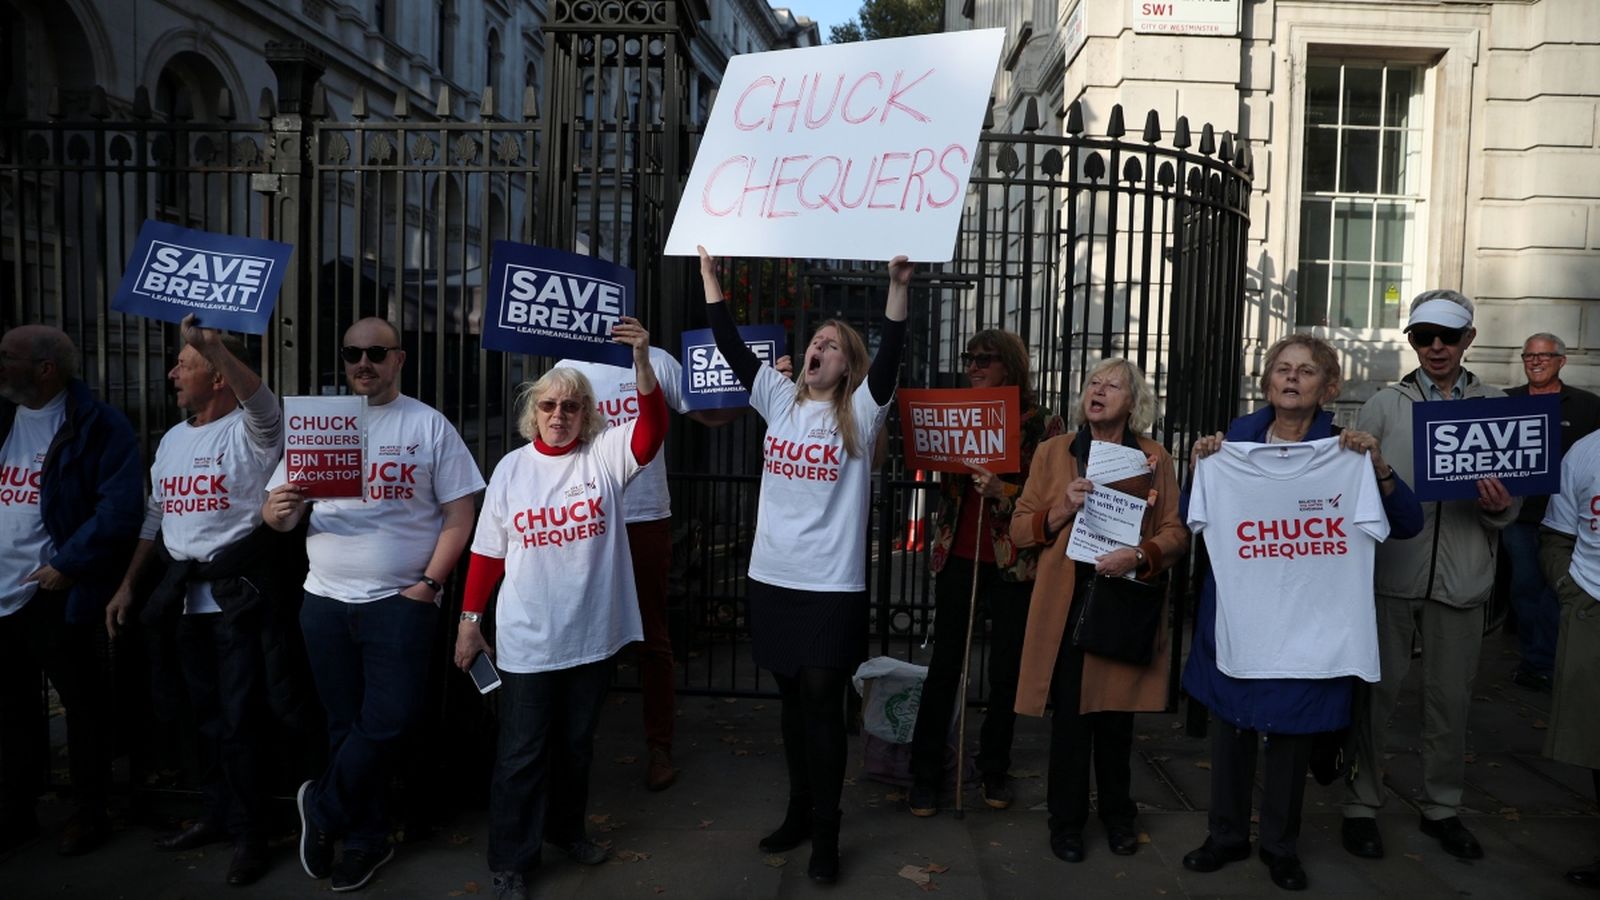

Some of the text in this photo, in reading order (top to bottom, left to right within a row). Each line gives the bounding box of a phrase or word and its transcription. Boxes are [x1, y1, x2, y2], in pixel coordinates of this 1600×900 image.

[1142, 3, 1173, 16] SW1
[1141, 23, 1155, 31] CITY
[1170, 24, 1219, 32] WESTMINSTER
[733, 68, 935, 133] CHUCK
[702, 143, 969, 219] CHEQUERS
[151, 247, 267, 286] SAVE
[143, 271, 258, 305] BREXIT
[510, 270, 620, 315] SAVE
[507, 300, 620, 336] BREXIT
[692, 344, 770, 371] SAE
[693, 369, 741, 388] BRE
[289, 416, 358, 431] CHUCK
[913, 407, 1004, 427] BELIEVE IN
[287, 435, 360, 445] CHEQUERS
[914, 428, 1004, 455] BRITAIN
[1434, 419, 1542, 453] SAVE
[290, 453, 358, 466] BIN THE
[766, 459, 838, 481] HEQUERS
[1435, 448, 1542, 474] BREXIT
[160, 474, 229, 497] HUCK
[289, 470, 360, 481] BACKSTOP
[513, 496, 606, 533] CHUCK
[1097, 501, 1114, 511] with
[522, 520, 606, 549] HEQUERS
[1236, 517, 1347, 542] CHUCK
[1238, 541, 1348, 560] CHEQUERS
